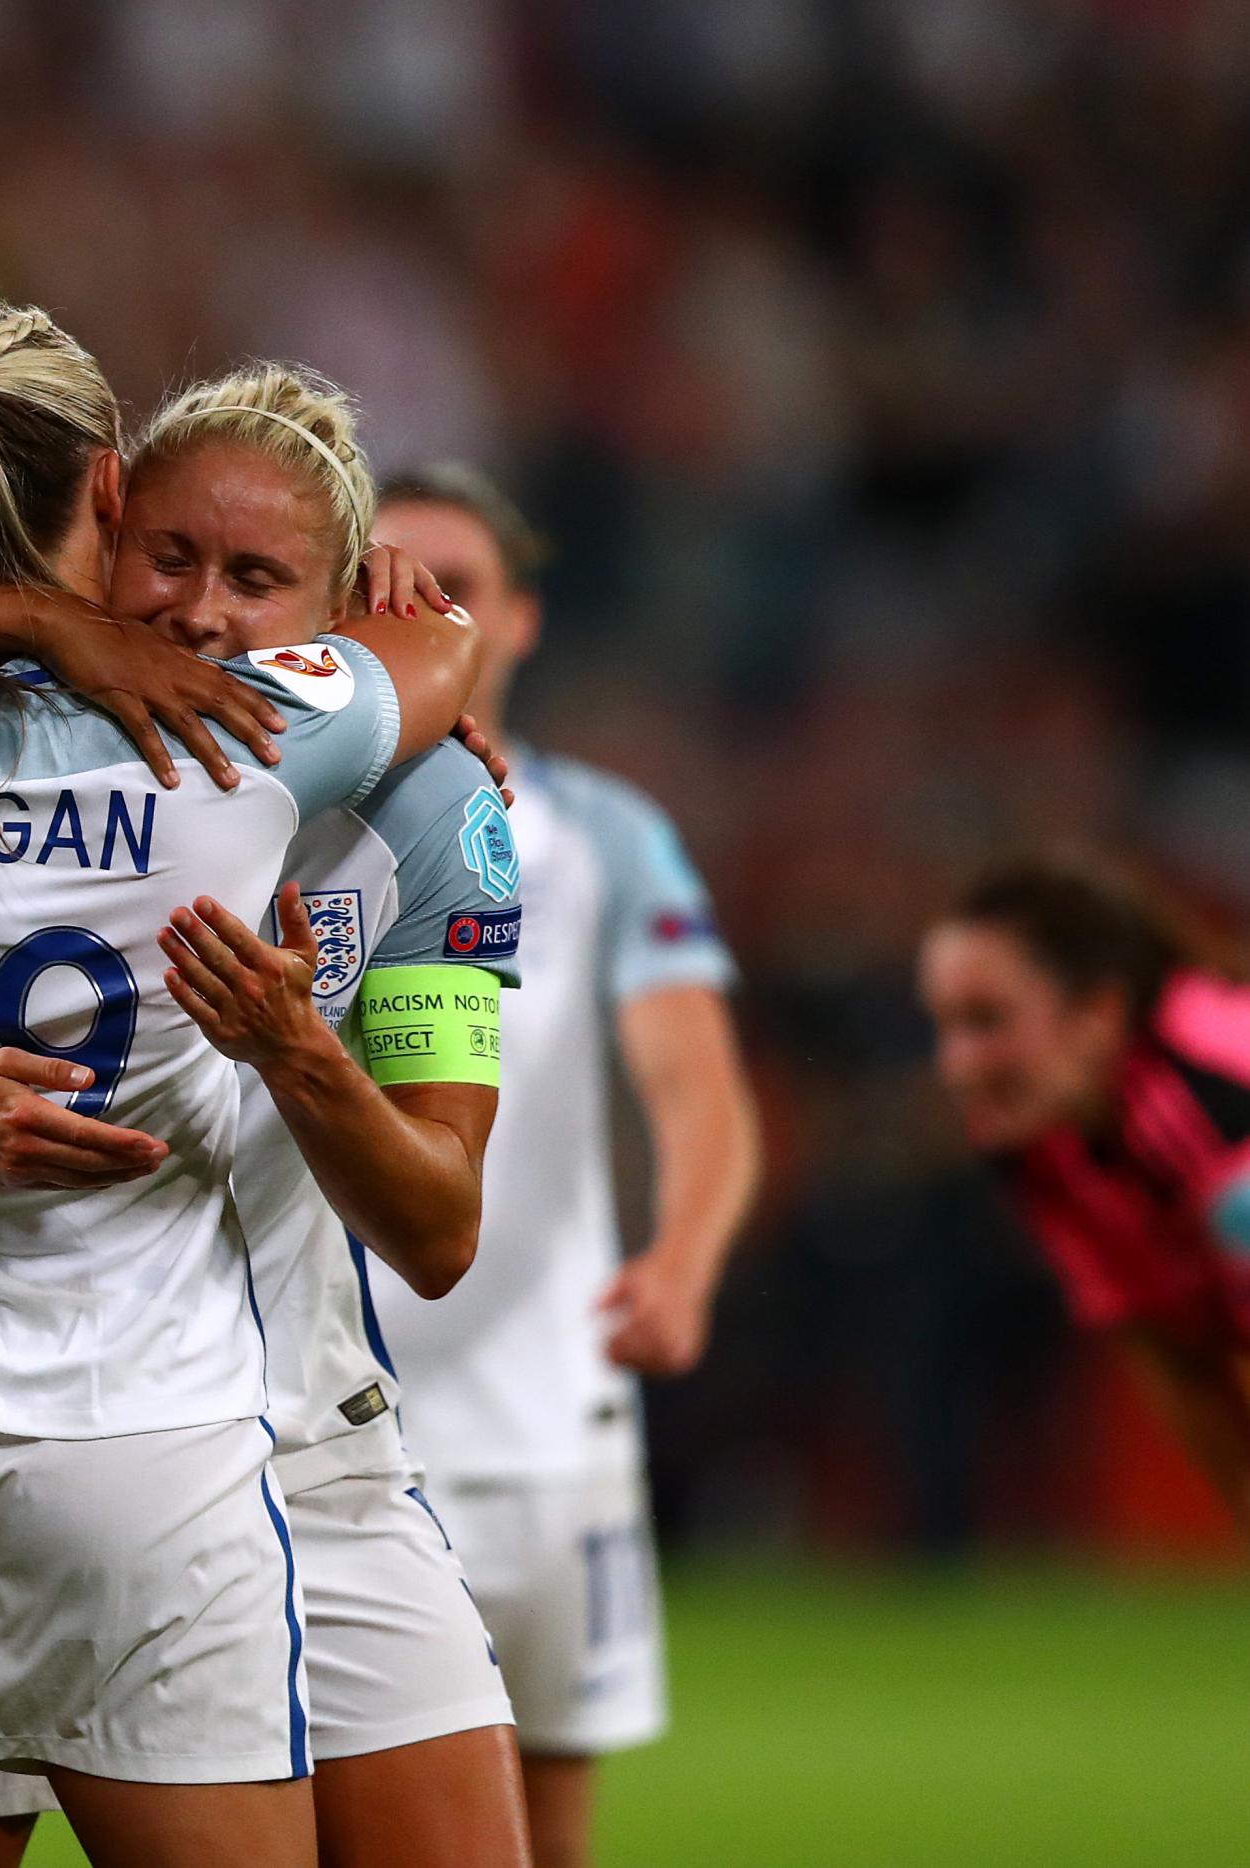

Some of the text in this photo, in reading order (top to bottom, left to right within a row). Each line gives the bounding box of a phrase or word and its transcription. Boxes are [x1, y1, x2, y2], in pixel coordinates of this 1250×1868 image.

[369, 994, 444, 1016] RACISM
[454, 994, 480, 1012] NO
[482, 996, 496, 1014] TO
